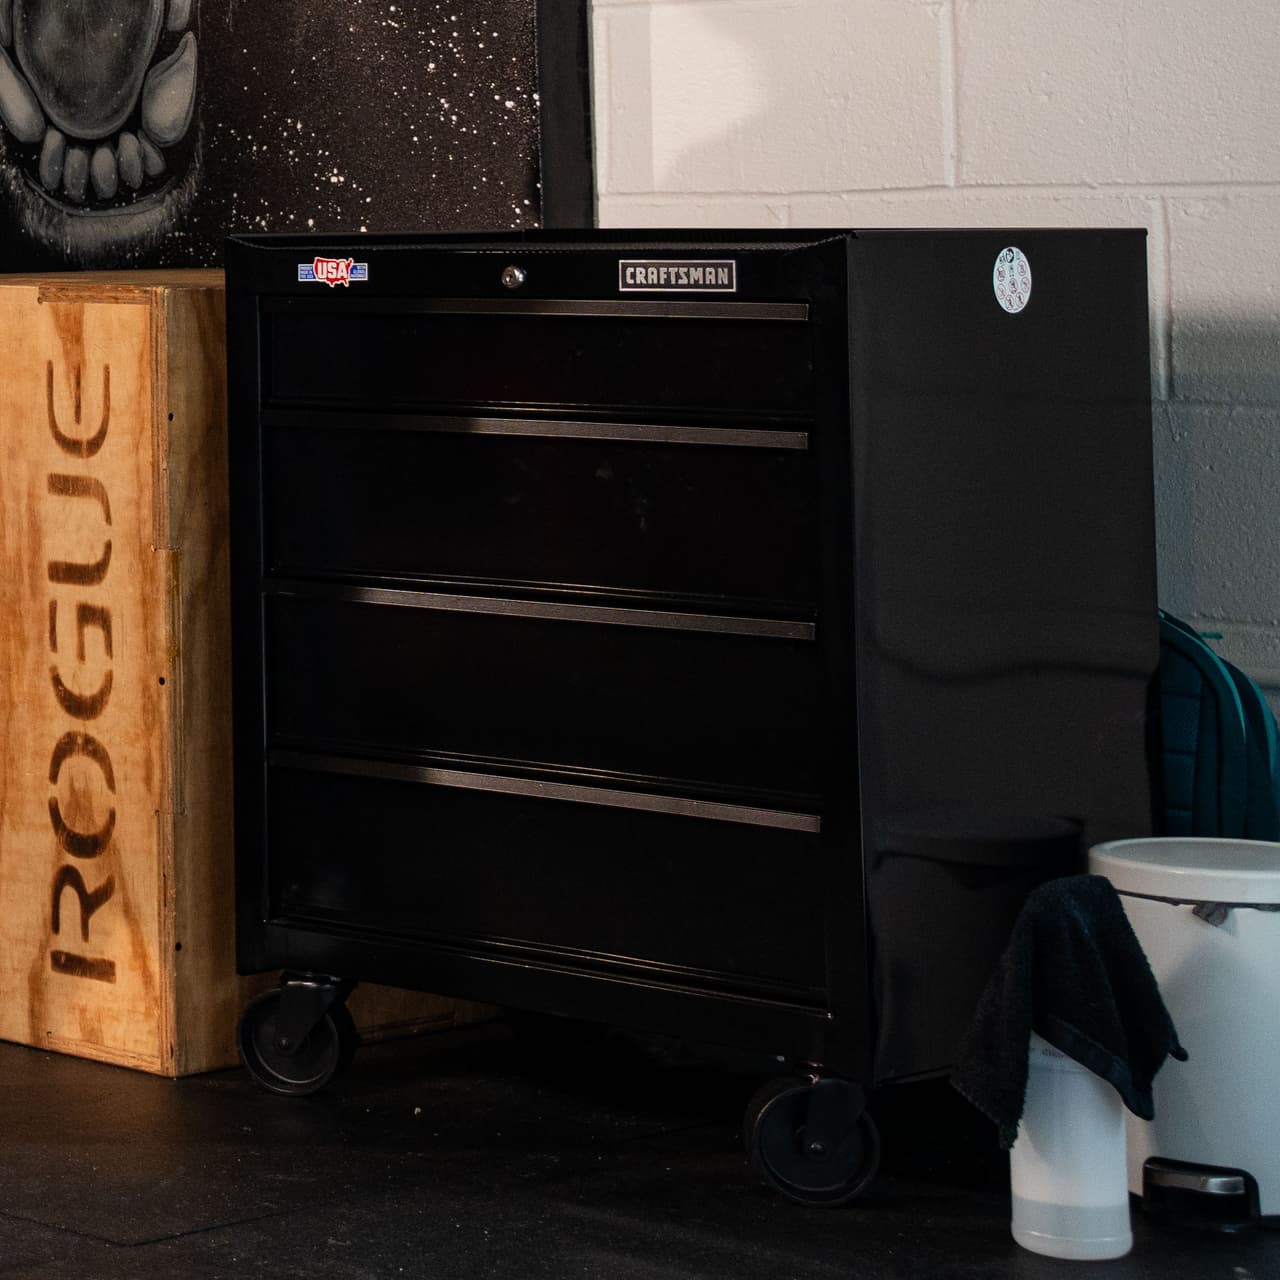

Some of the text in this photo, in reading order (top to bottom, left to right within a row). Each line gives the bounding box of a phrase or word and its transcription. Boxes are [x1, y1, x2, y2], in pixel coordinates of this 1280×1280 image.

[316, 260, 348, 279] USA
[625, 267, 729, 285] CRAFTSMAN
[46, 359, 117, 985] ROGUE
